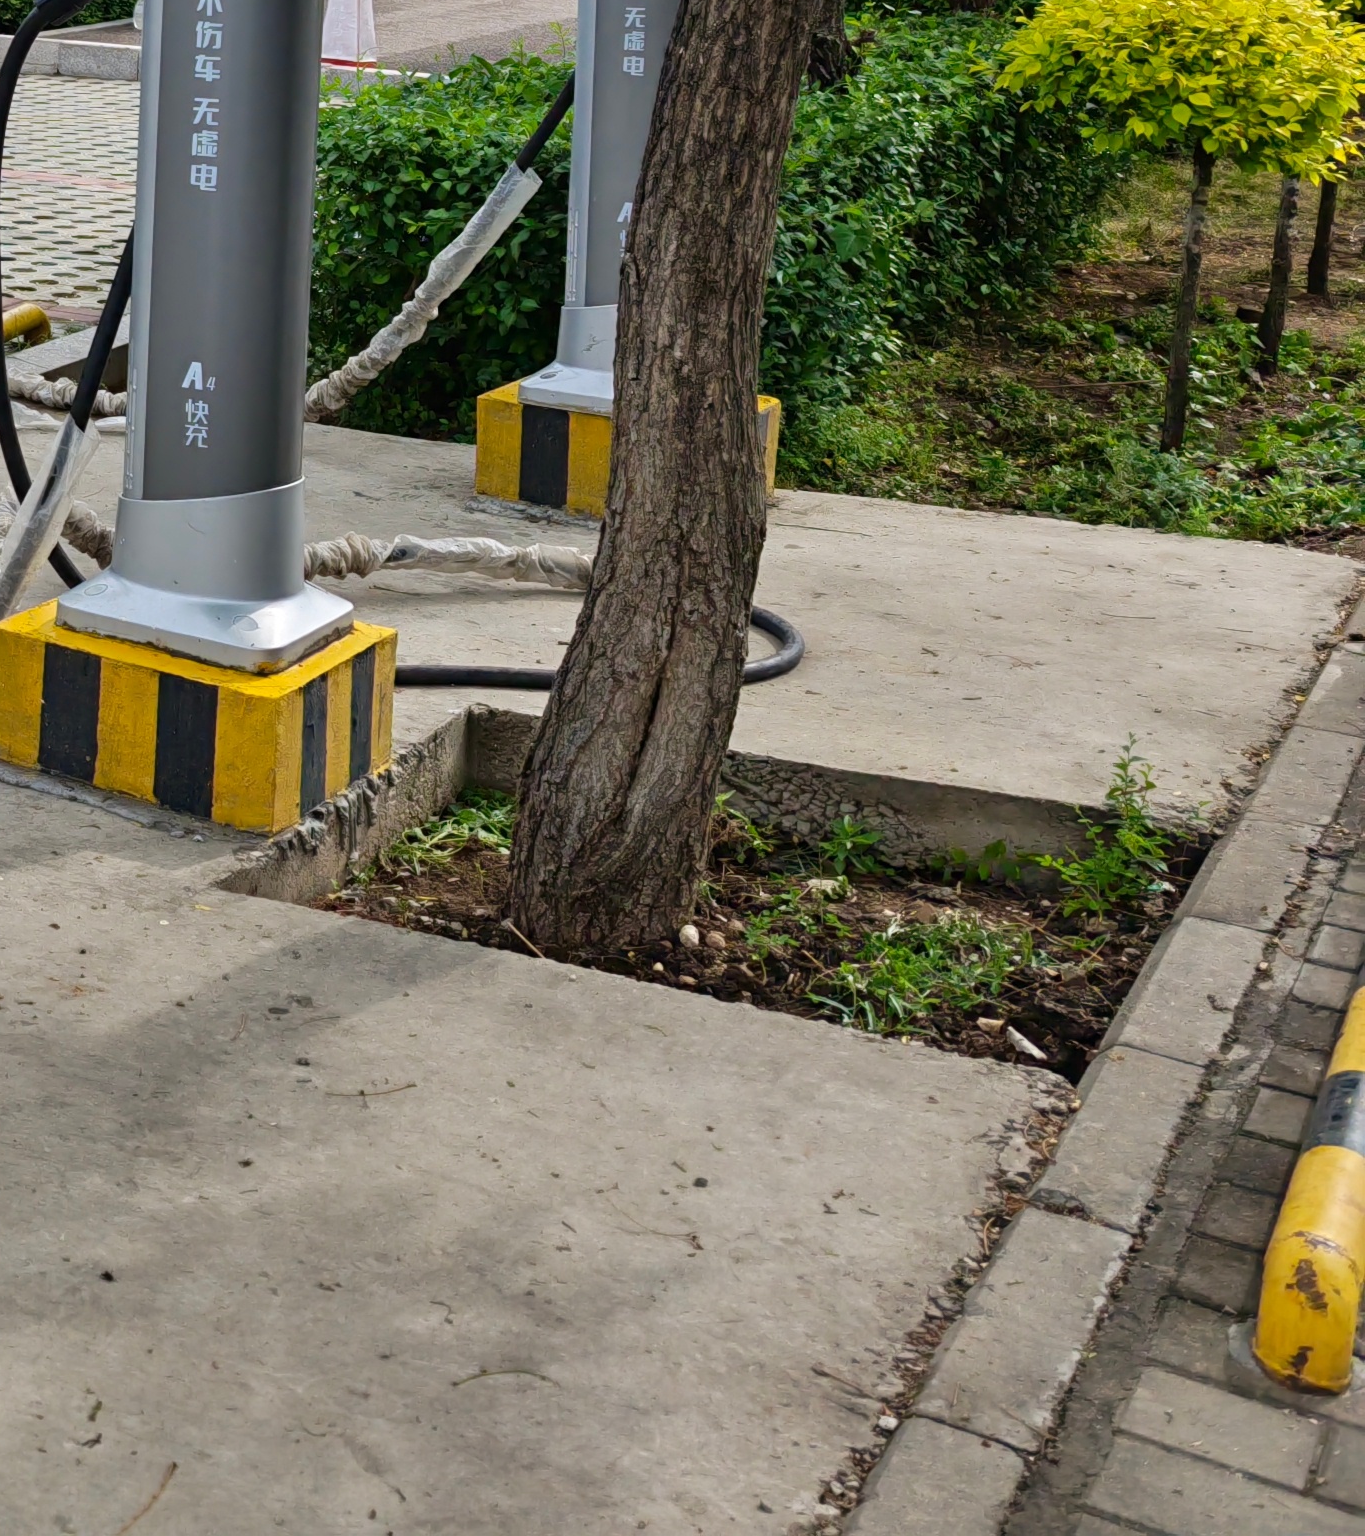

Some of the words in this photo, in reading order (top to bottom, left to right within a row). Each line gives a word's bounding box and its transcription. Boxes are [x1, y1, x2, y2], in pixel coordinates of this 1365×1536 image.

[622, 7, 646, 78] 无虚电
[190, 97, 220, 192] 无虚电
[184, 398, 209, 449] 快充
